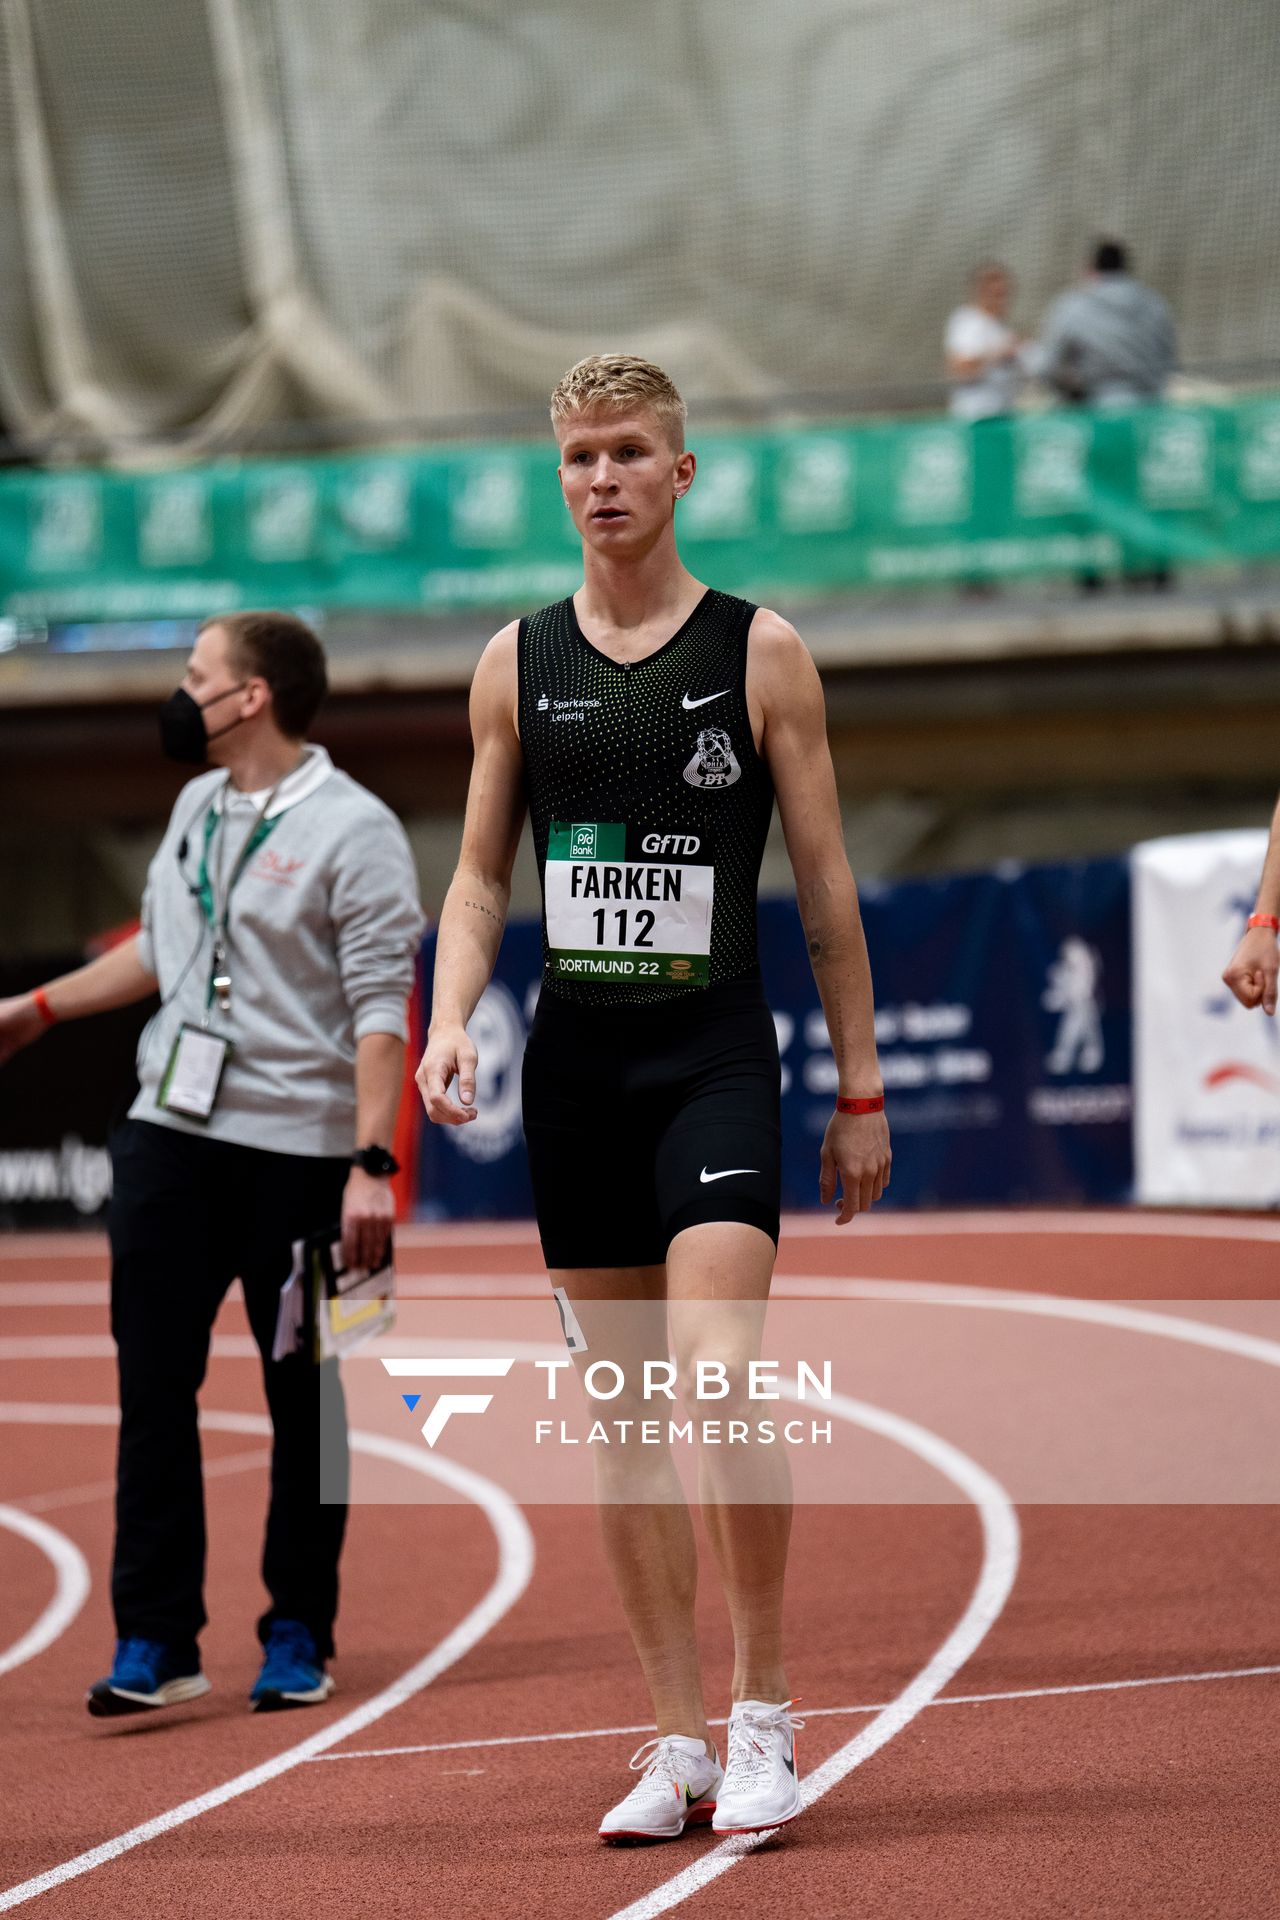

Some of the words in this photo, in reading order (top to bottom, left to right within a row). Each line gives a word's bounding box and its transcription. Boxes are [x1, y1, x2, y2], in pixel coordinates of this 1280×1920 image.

[552, 699, 600, 710] Sparkasse
[551, 710, 585, 722] Leipzig
[572, 845, 594, 855] Bank
[641, 833, 701, 855] GfTD
[571, 865, 682, 901] FARKEN
[592, 908, 656, 947] 112
[559, 958, 635, 975] DORTMUND
[638, 961, 660, 975] 22
